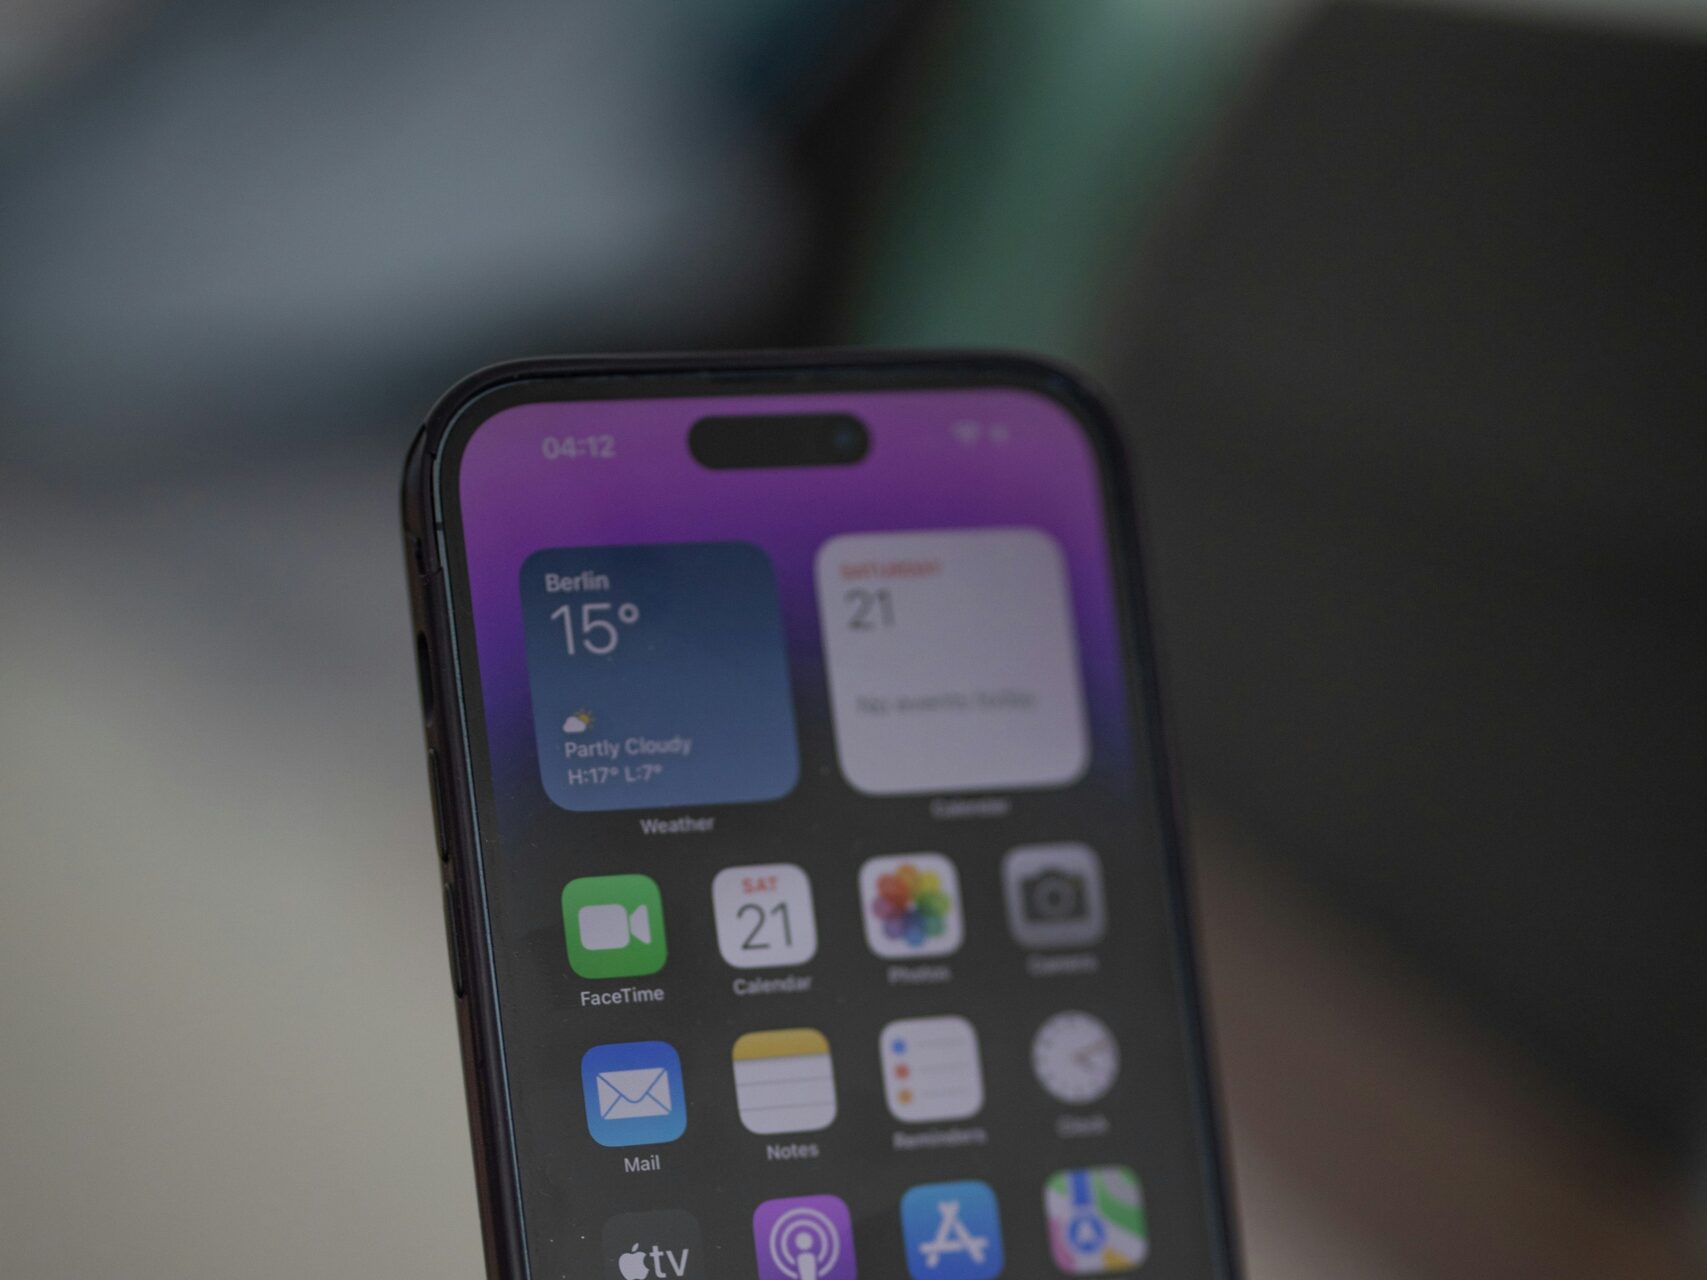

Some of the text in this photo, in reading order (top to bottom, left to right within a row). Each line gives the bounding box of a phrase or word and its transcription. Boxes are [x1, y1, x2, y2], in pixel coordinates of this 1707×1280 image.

[541, 434, 616, 460] 04:12
[545, 570, 610, 592] Berlin
[844, 588, 895, 630] 21
[550, 602, 640, 656] 15°
[565, 736, 692, 759] Partly Cloudy
[640, 815, 715, 834] Weather
[742, 876, 777, 895] SAT
[737, 901, 792, 950] 21
[580, 986, 664, 1006] FaceTime
[733, 975, 812, 996] Calendar
[766, 1142, 819, 1161] Notes
[624, 1154, 661, 1173] Mail
[649, 1245, 689, 1278] tv
